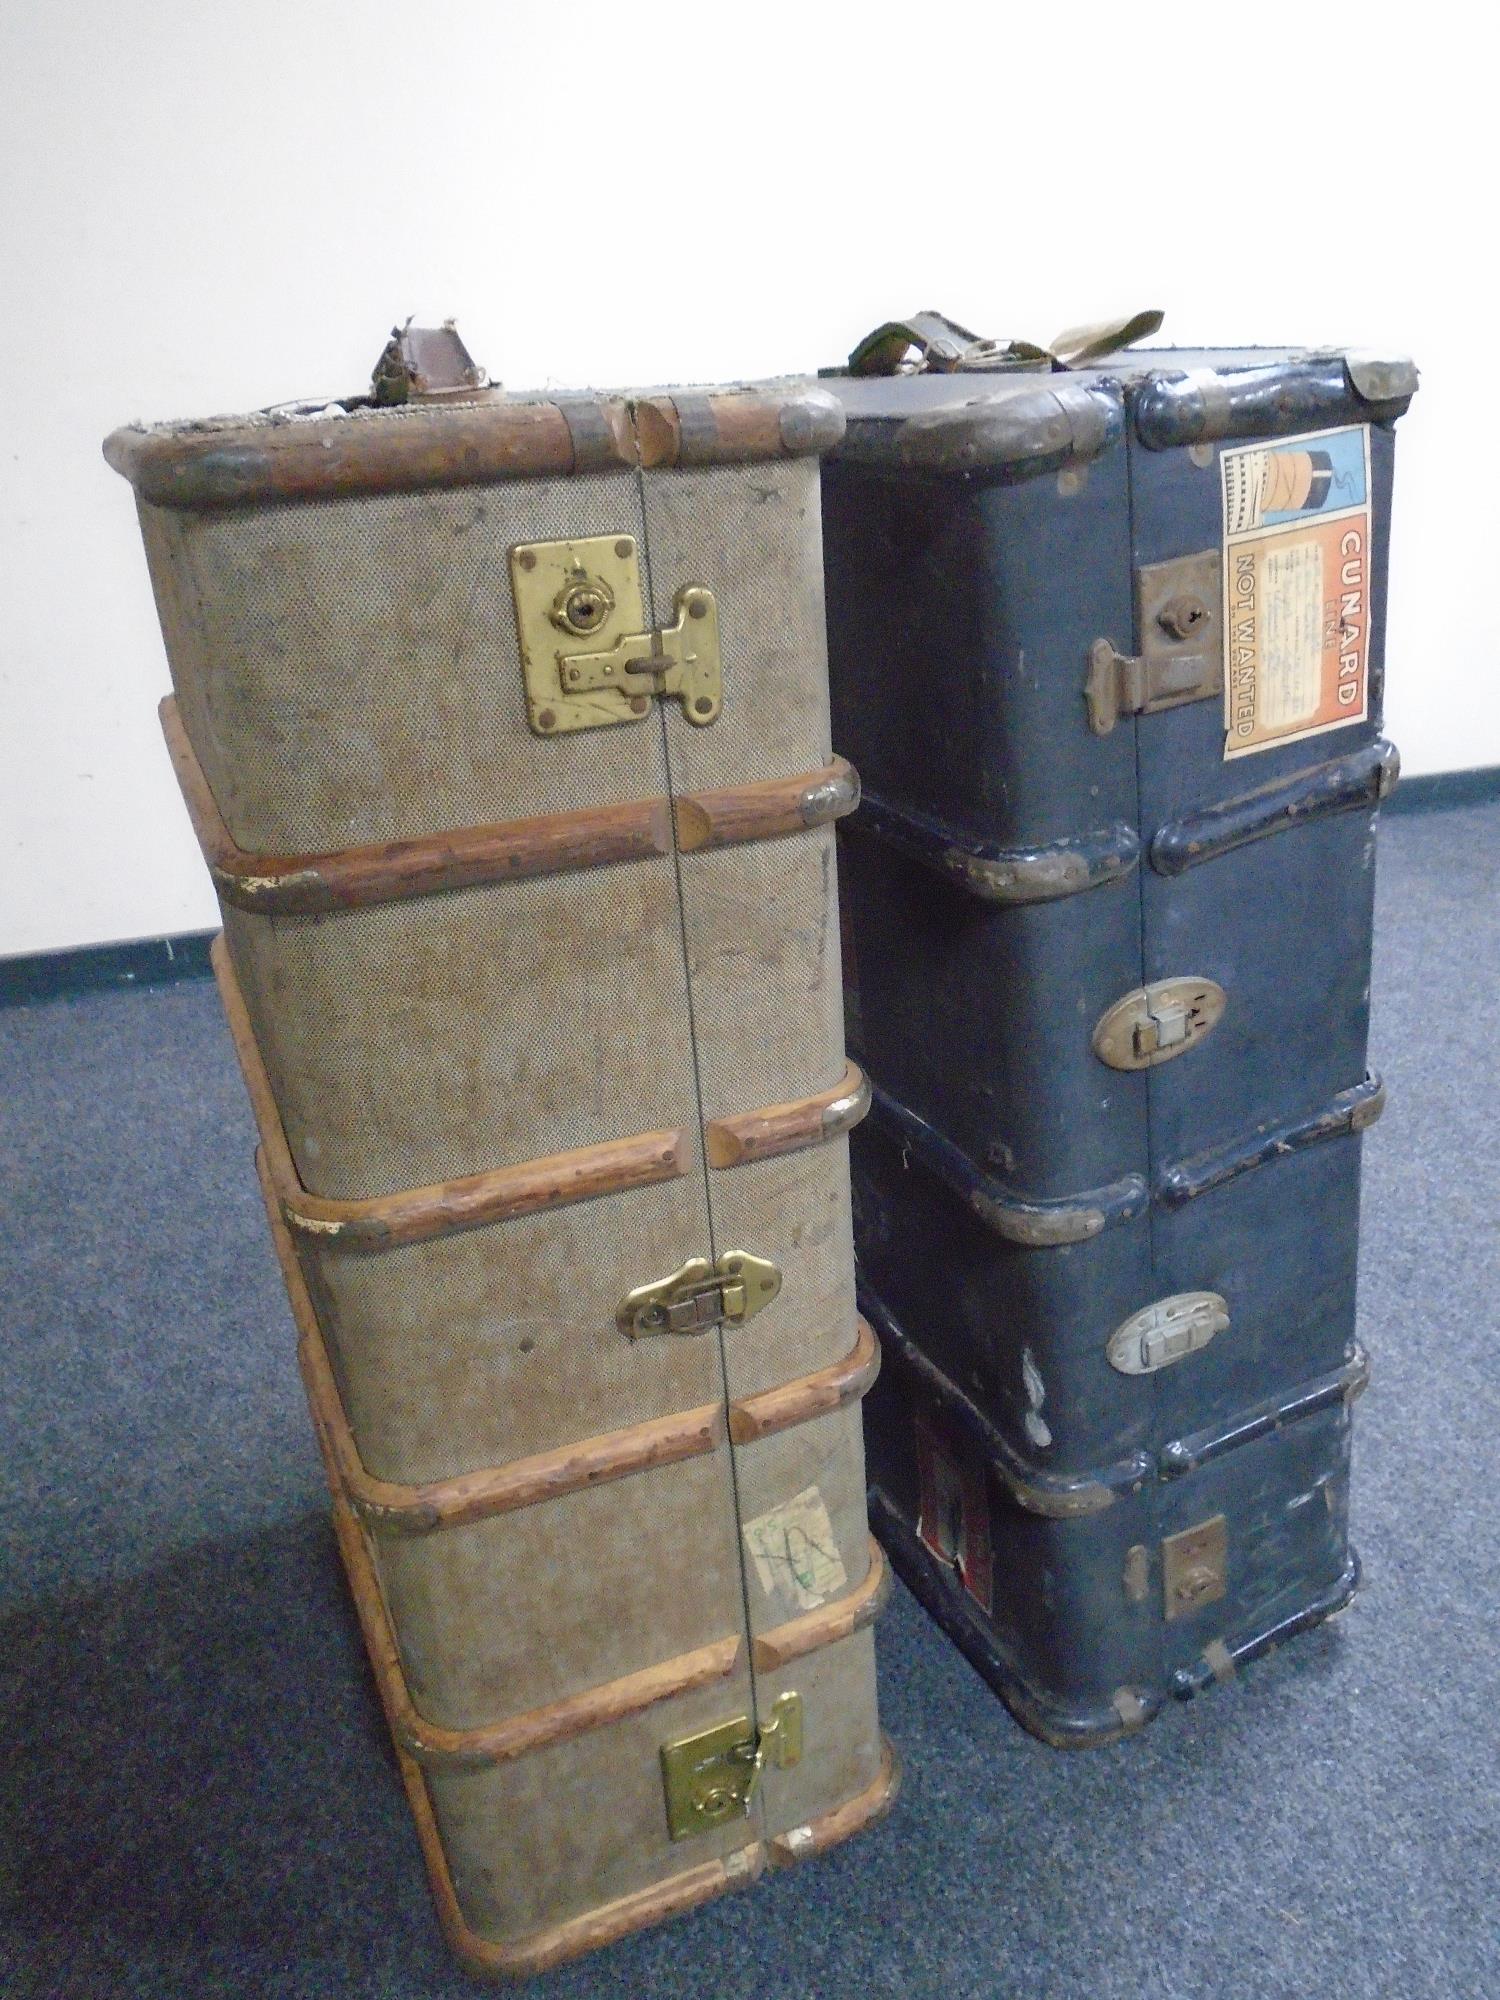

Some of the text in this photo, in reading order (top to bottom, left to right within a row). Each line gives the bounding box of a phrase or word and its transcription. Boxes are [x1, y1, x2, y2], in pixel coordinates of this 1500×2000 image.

[1231, 650, 1239, 689] VOYAGE
[1237, 553, 1255, 737] NOT WANTED
[1324, 600, 1338, 649] LINE
[1338, 530, 1362, 705] CUNARD
